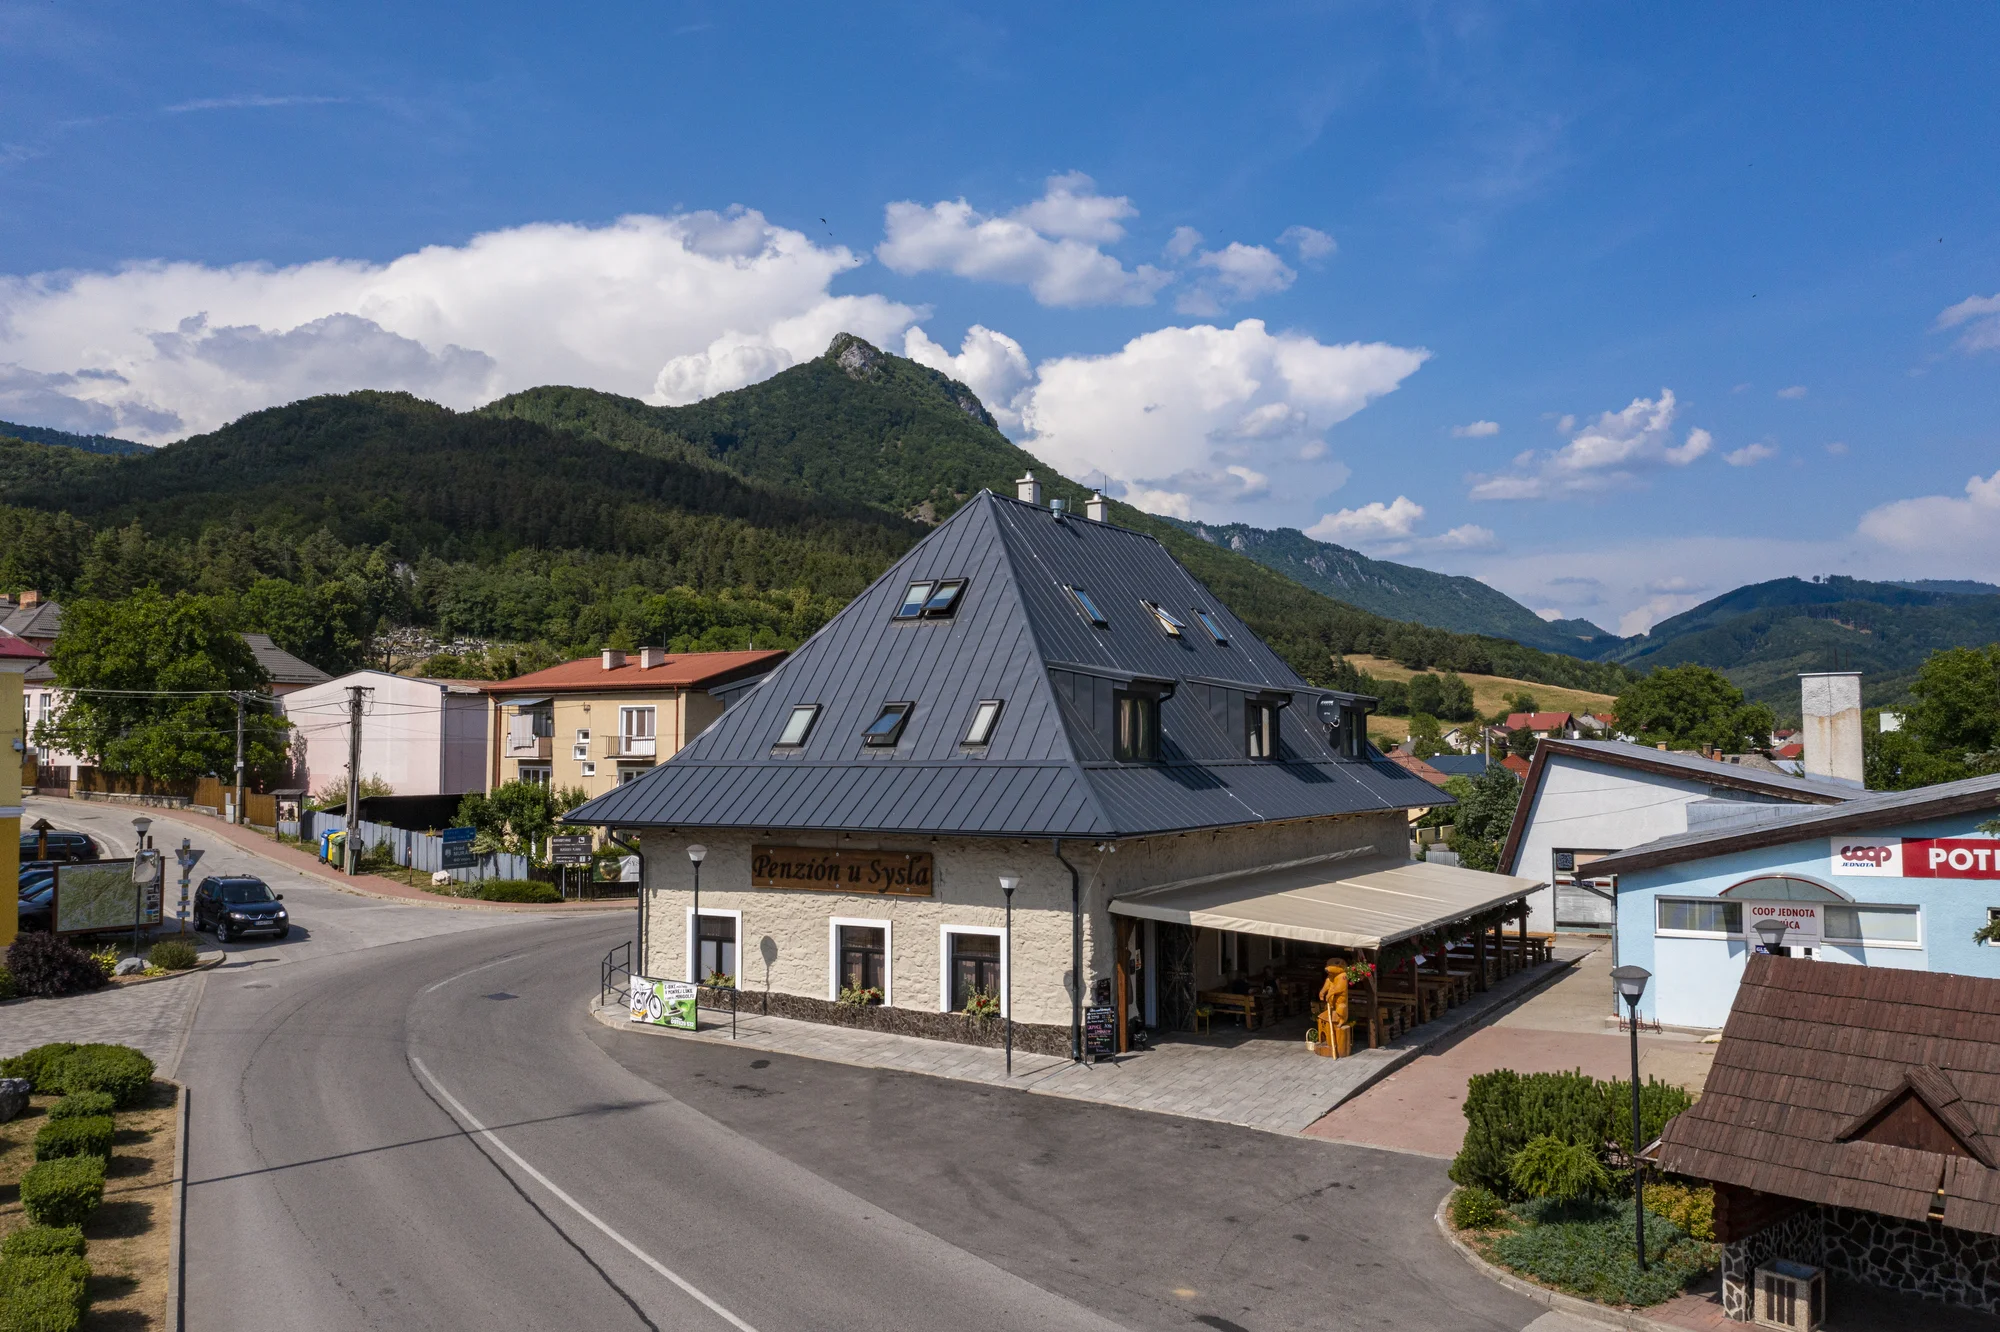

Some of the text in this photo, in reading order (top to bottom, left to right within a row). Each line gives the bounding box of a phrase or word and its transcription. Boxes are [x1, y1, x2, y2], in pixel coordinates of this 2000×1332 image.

[1929, 847, 2000, 872] POT
[753, 854, 929, 893] Penzión u Sysľa
[1752, 907, 1815, 918] COOP JEDNOTA
